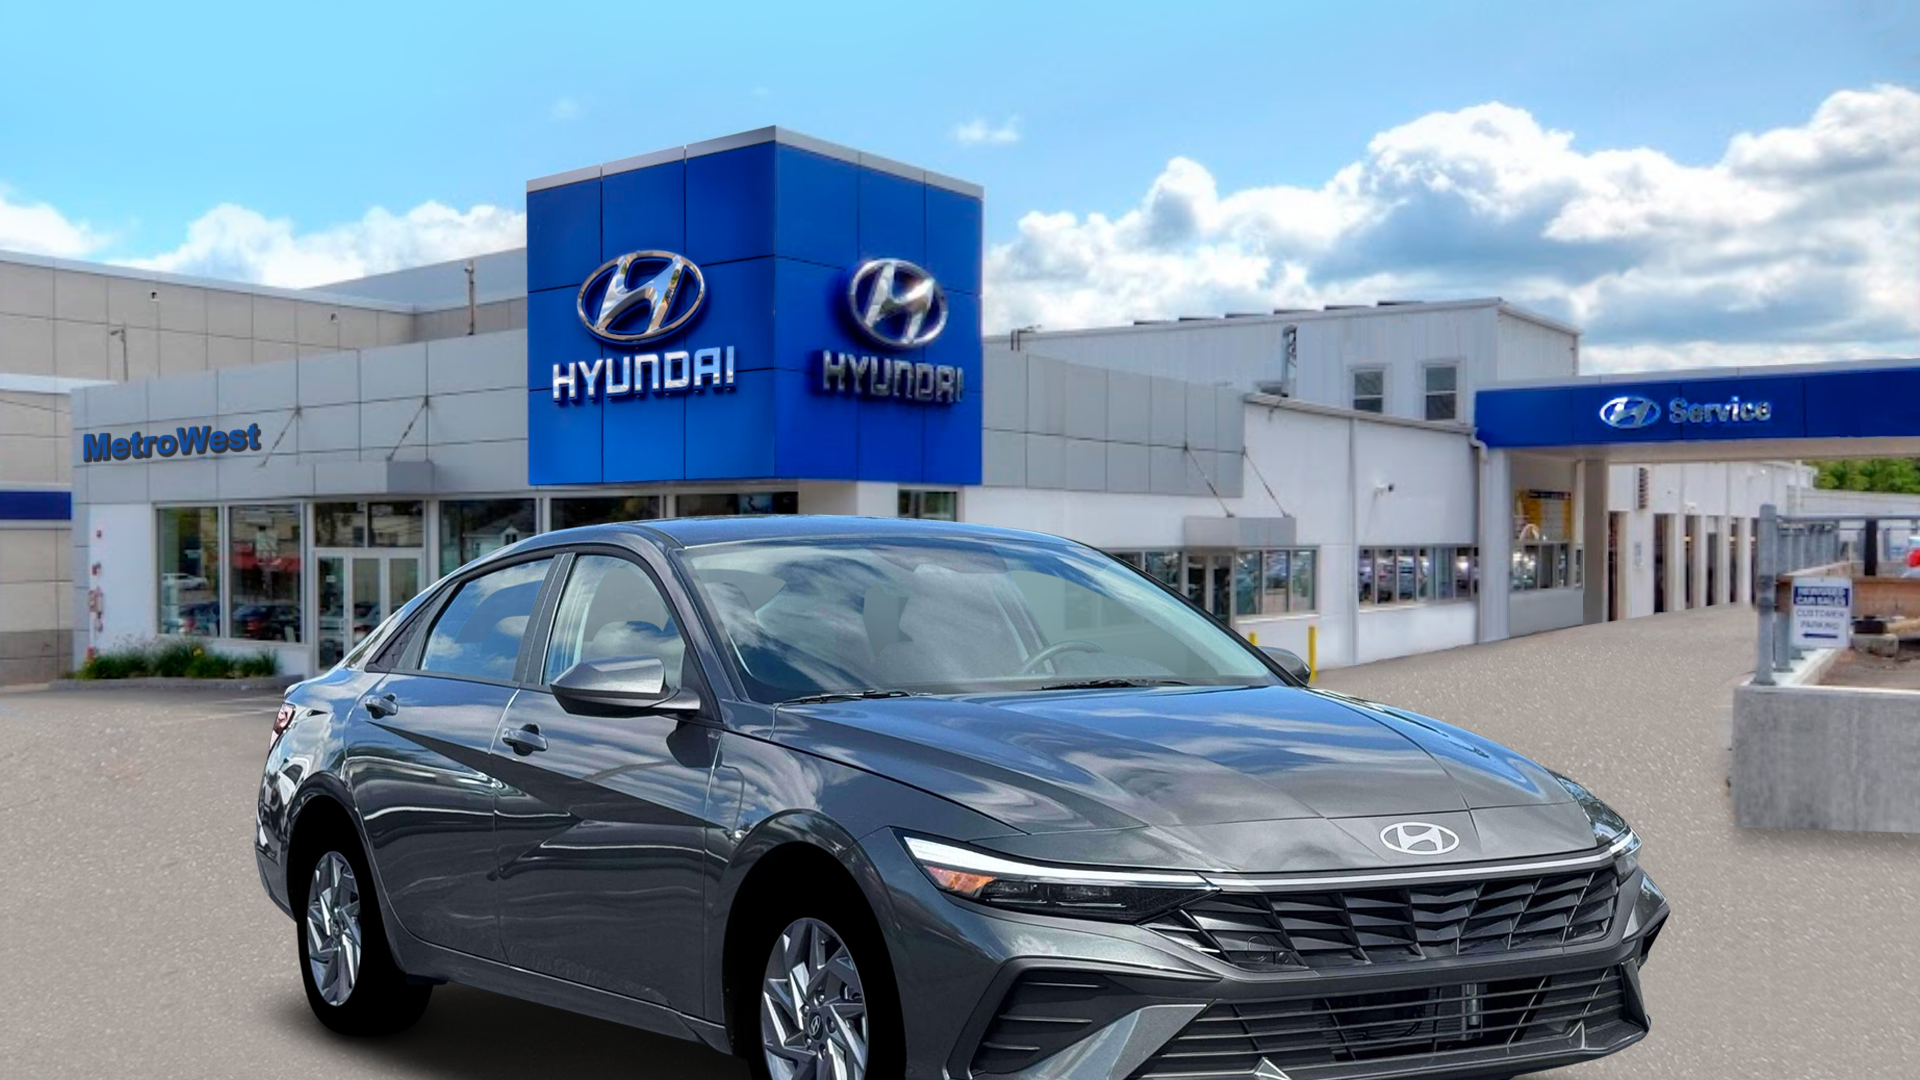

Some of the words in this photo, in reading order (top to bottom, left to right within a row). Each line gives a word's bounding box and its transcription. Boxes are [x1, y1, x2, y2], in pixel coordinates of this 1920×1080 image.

[552, 345, 736, 402] HYUNDAI
[822, 350, 965, 404] HYUNDAI
[1668, 396, 1772, 423] Service
[83, 423, 261, 463] MetroWest
